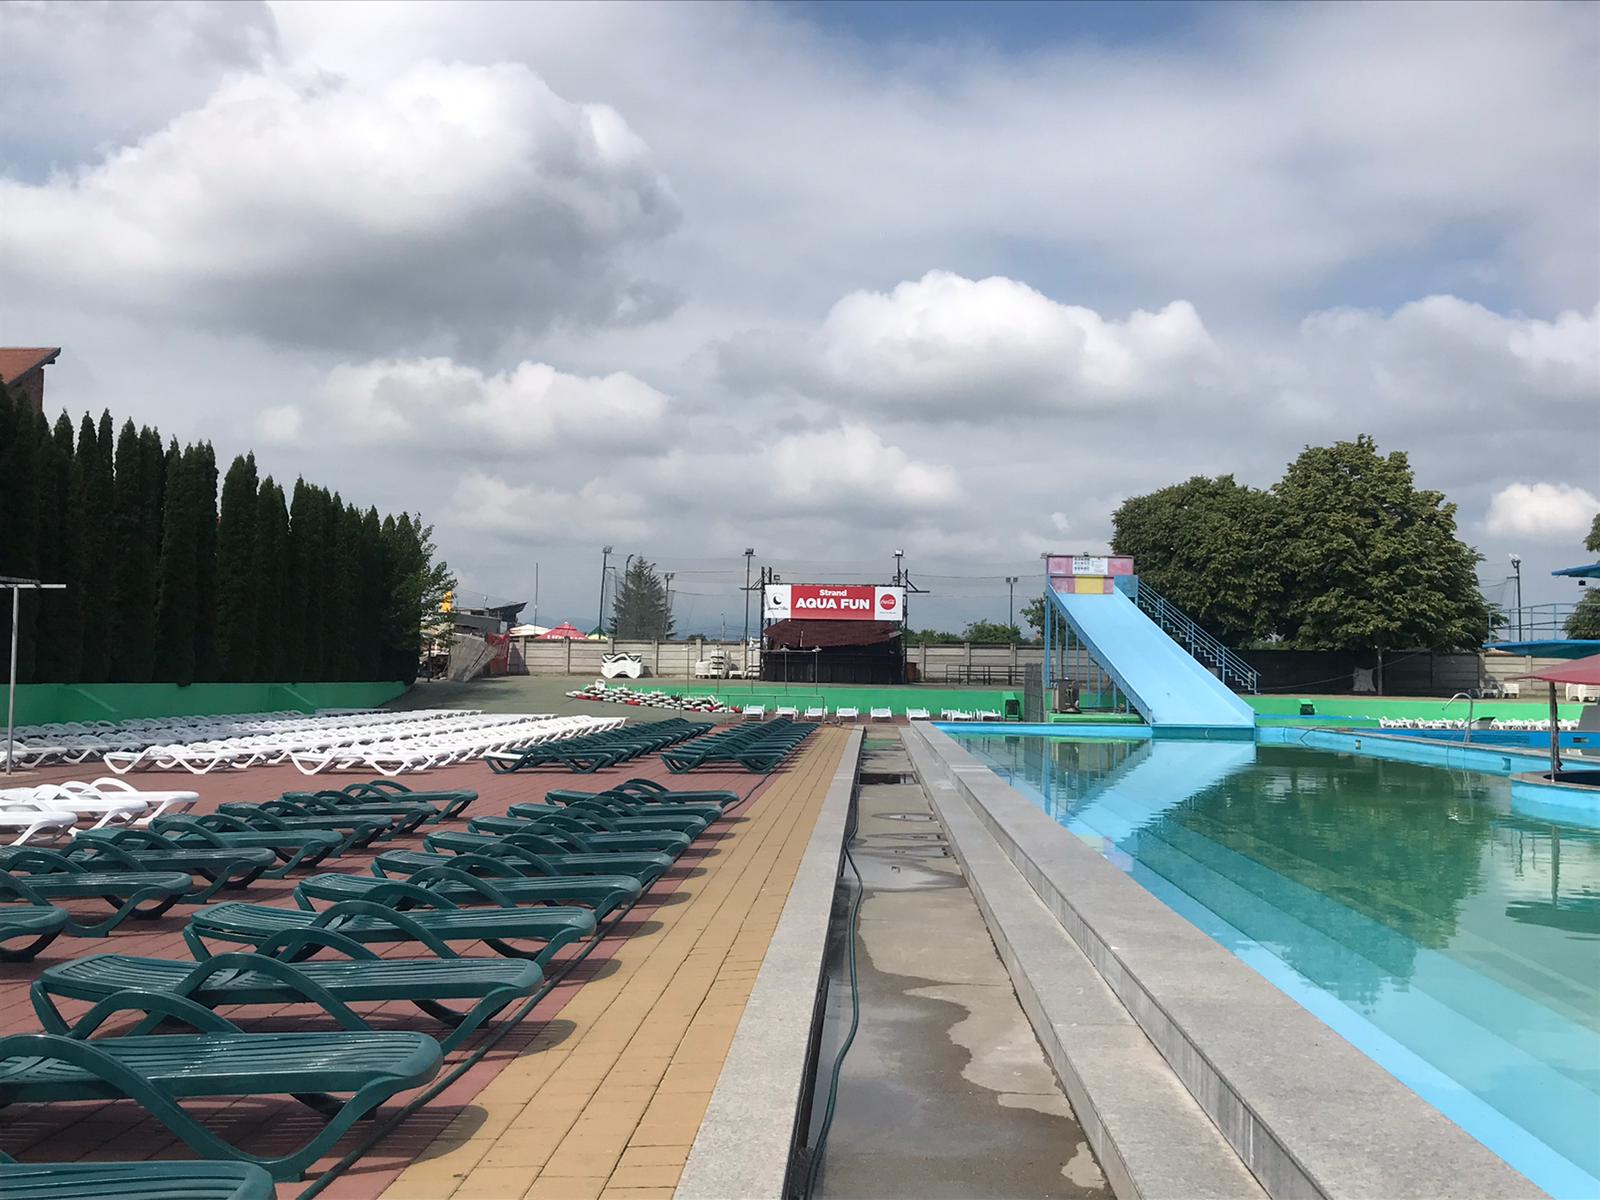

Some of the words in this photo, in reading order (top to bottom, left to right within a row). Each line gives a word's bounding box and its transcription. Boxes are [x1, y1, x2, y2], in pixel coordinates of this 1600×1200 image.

[819, 589, 847, 597] Strand
[795, 597, 837, 609] AQUA
[840, 598, 870, 610] FUN
